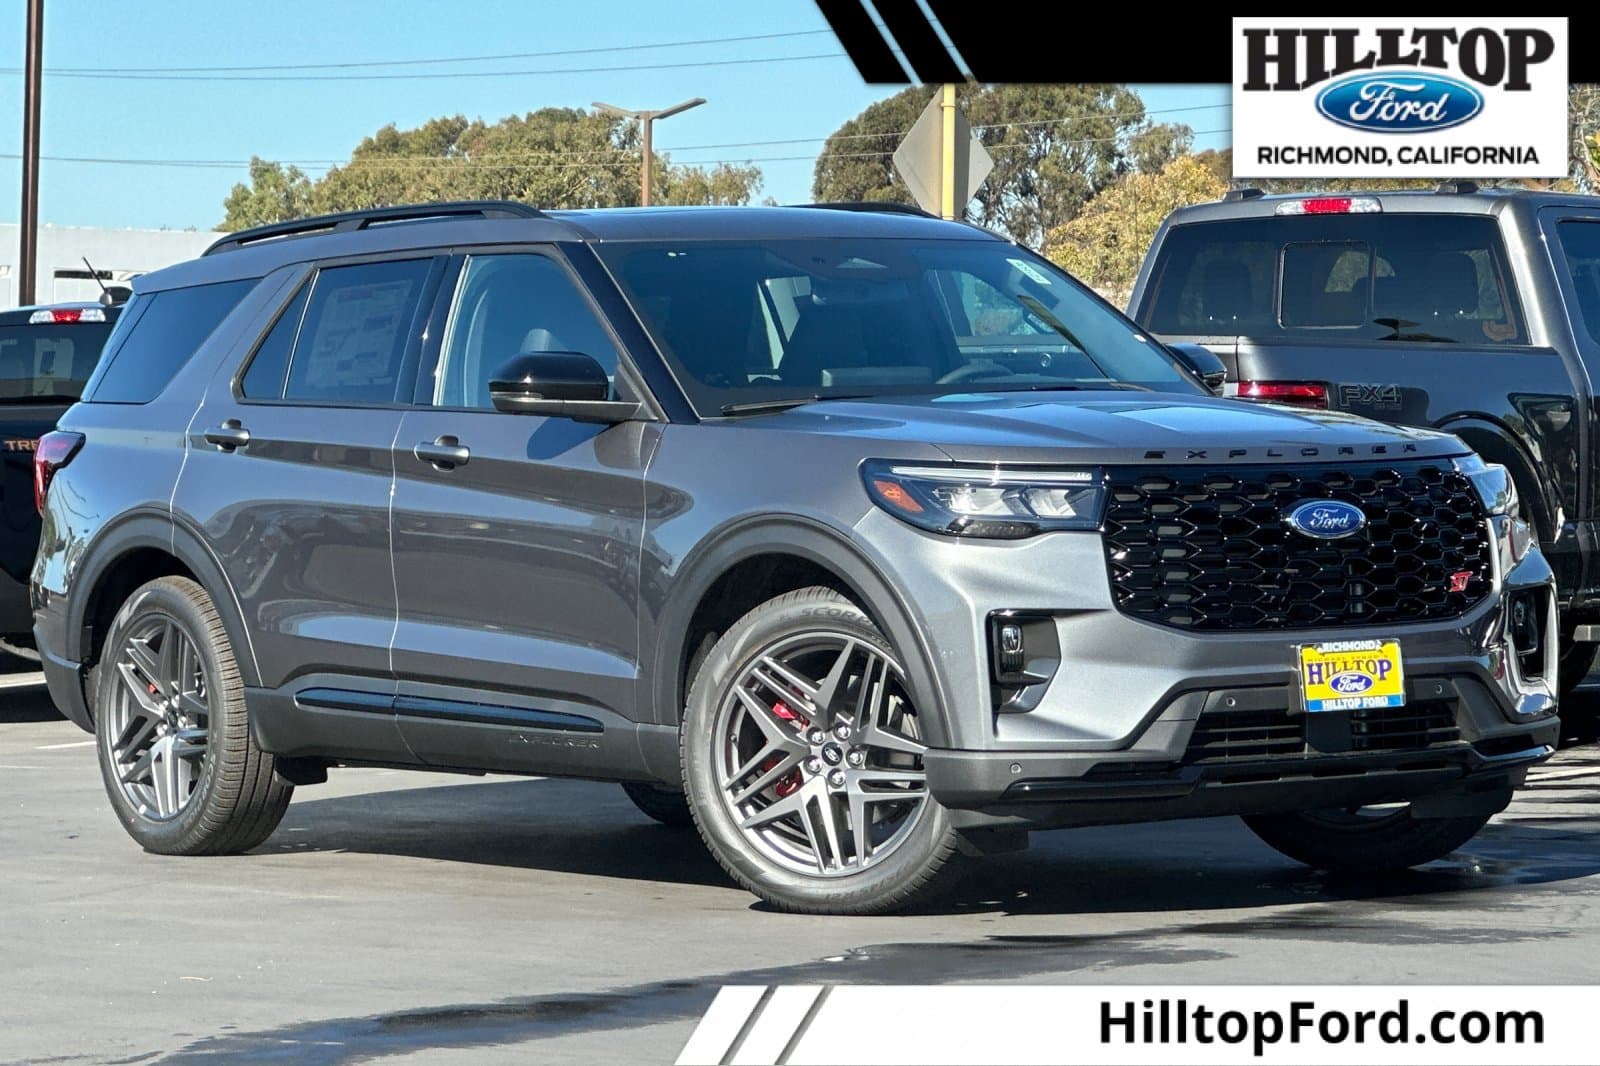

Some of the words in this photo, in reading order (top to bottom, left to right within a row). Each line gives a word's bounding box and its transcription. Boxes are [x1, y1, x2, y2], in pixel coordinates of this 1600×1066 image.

[1339, 384, 1402, 408] FX4
[1144, 443, 1417, 459] EXPLORER
[1310, 508, 1350, 529] Ford
[1449, 571, 1473, 592] ST
[1321, 640, 1377, 653] RICHMOND
[1307, 659, 1392, 685] HILLTOP
[1337, 675, 1367, 691] Ford
[1322, 696, 1361, 711] HILLTOP
[1363, 695, 1388, 708] FORD
